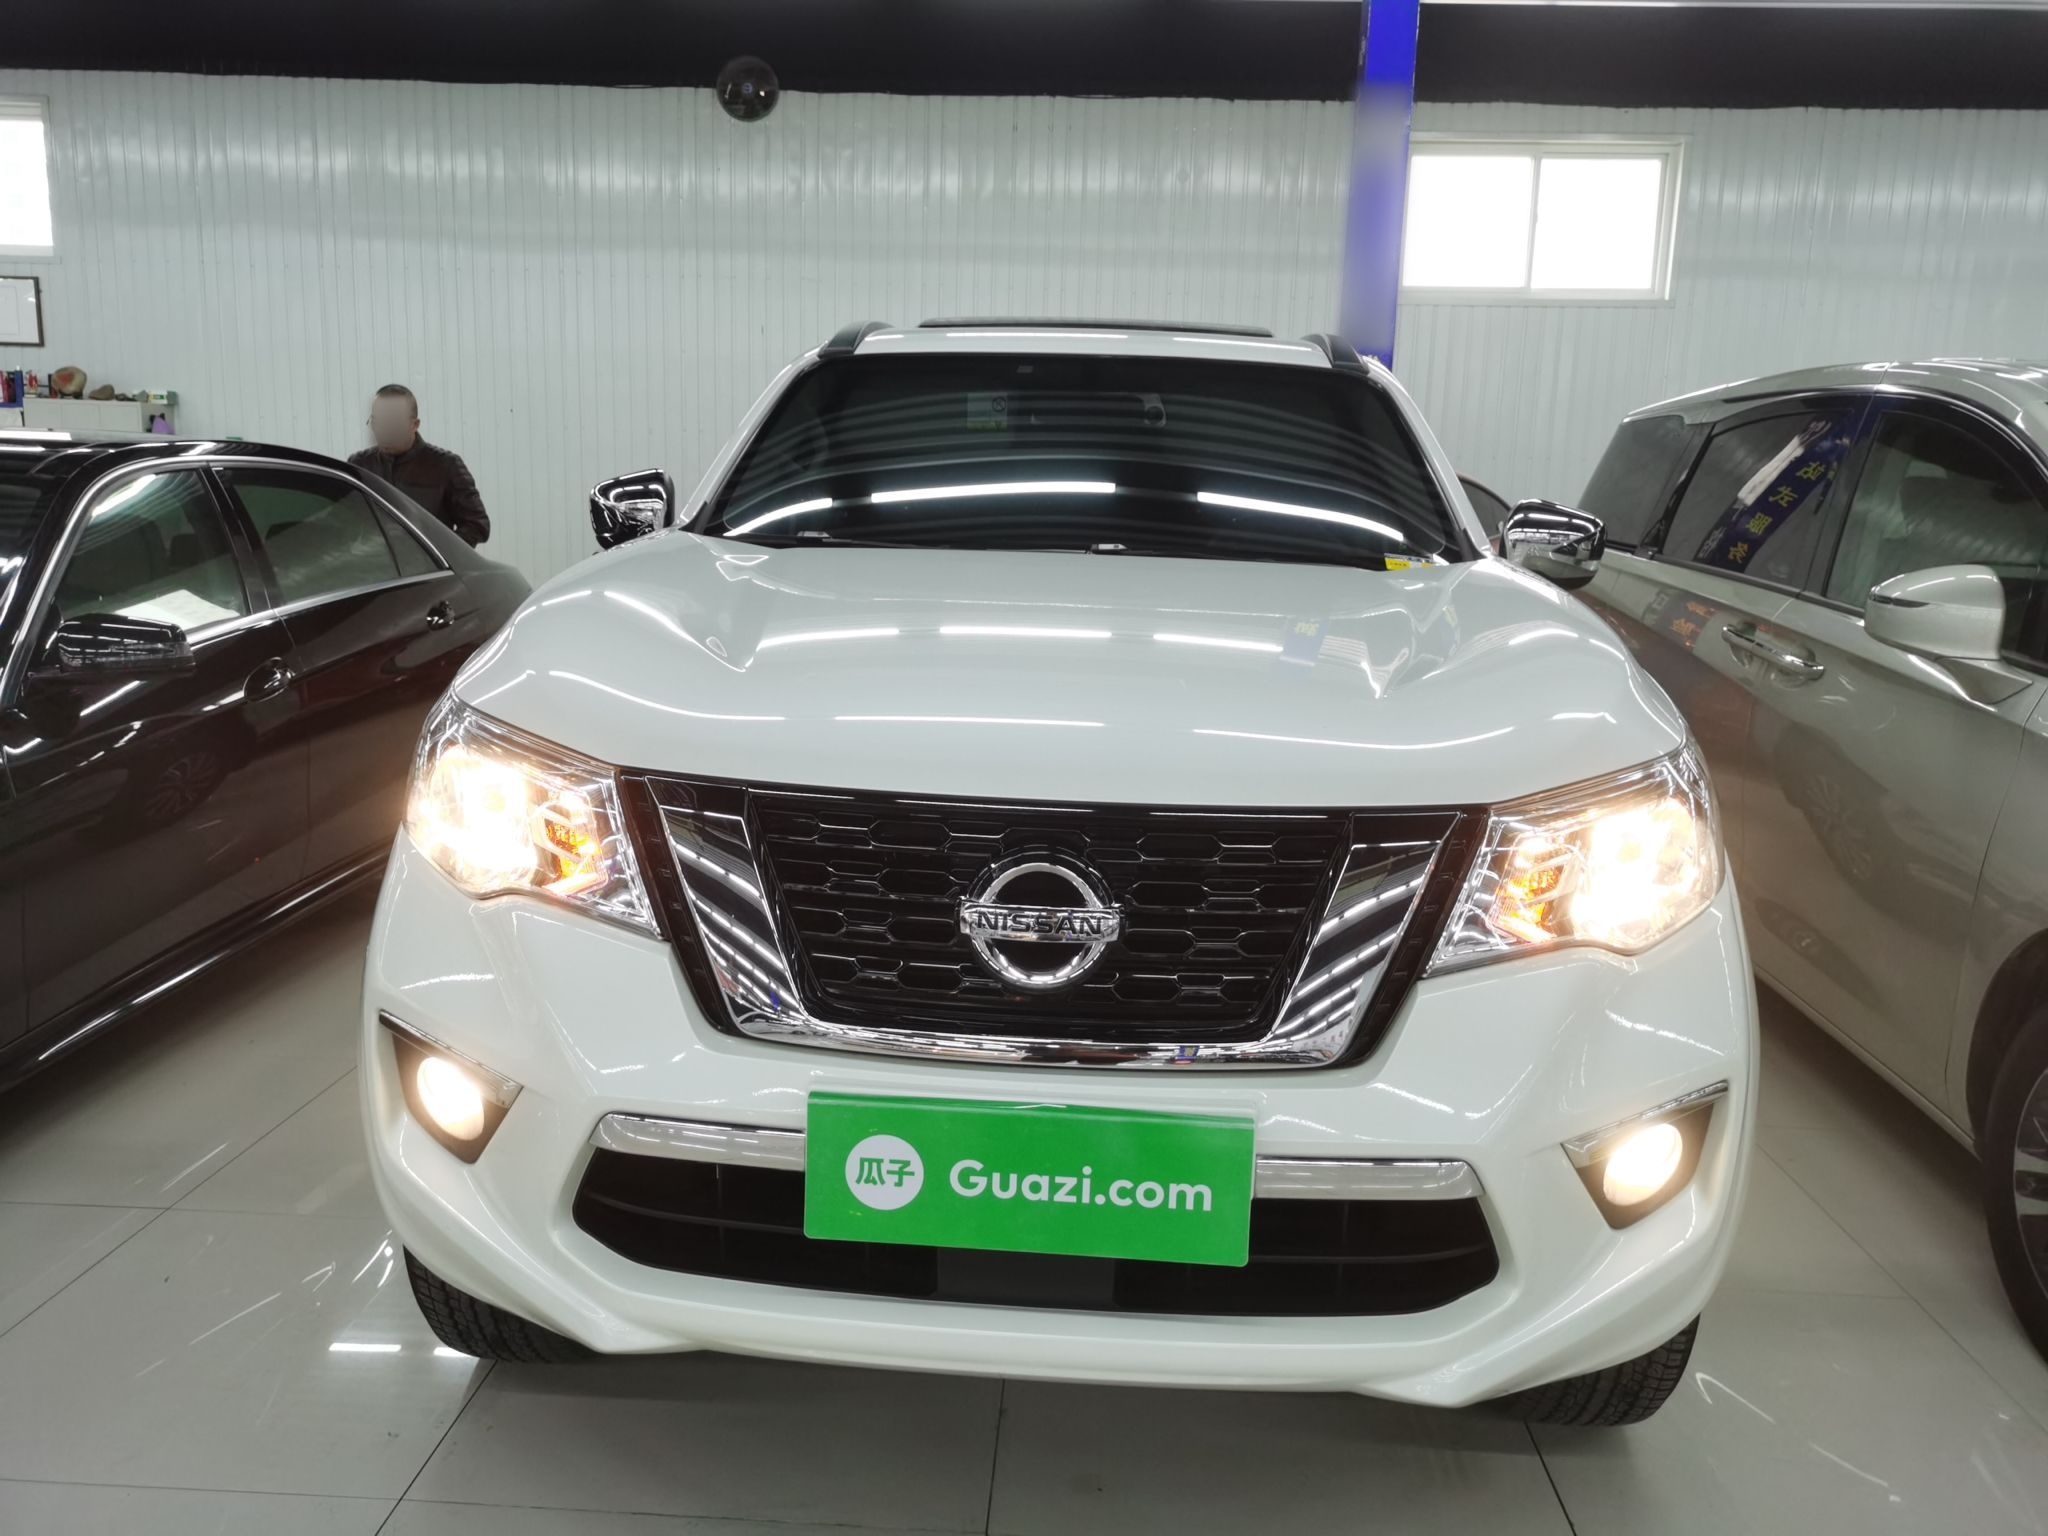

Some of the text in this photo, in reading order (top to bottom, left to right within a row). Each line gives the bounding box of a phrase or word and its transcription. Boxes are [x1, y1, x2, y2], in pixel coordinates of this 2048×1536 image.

[977, 911, 1102, 935] NISSAN
[855, 1157, 915, 1188] 瓜子
[949, 1158, 1212, 1212] Guazi.com
